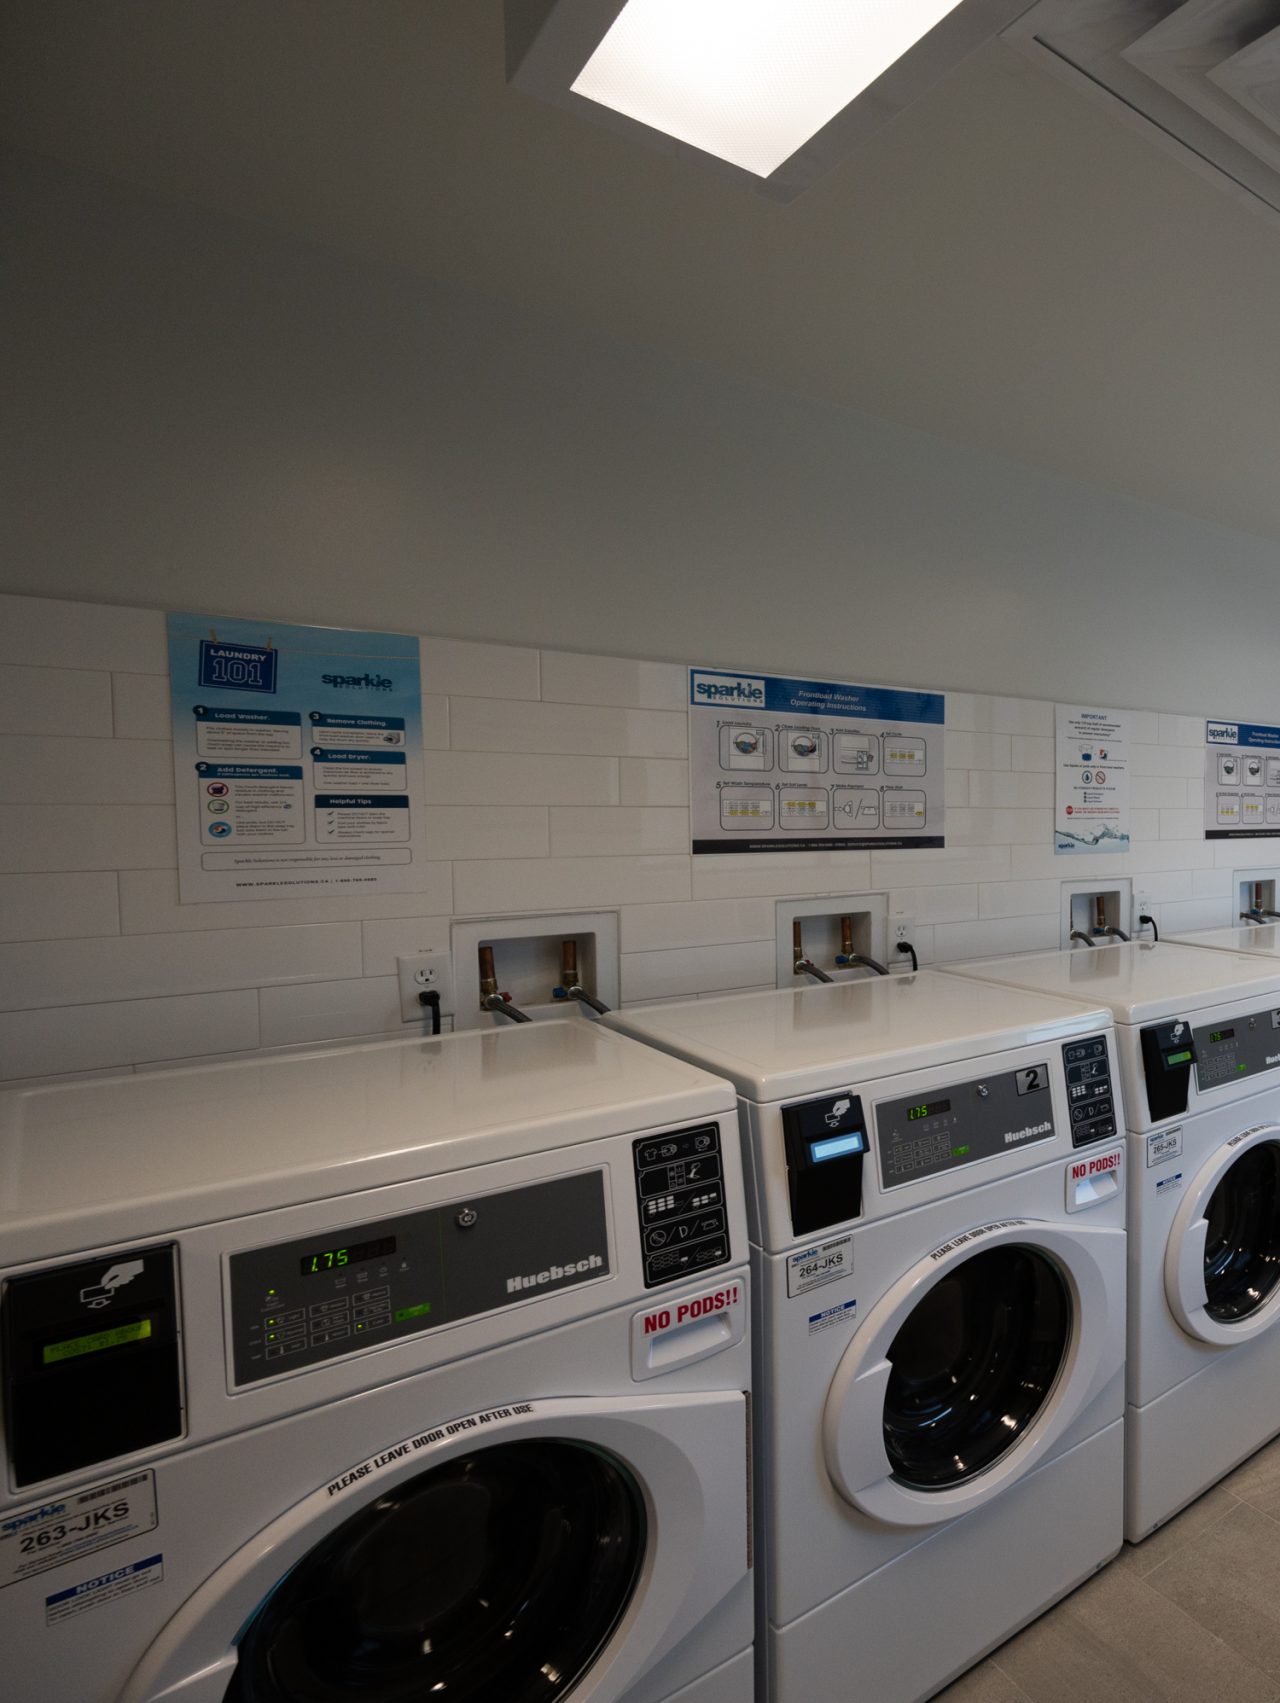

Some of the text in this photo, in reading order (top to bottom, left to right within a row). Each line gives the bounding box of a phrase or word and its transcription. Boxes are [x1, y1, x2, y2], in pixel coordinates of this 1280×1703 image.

[210, 648, 267, 661] LAUNDRY
[212, 658, 263, 686] 101
[321, 673, 392, 688] sparkle
[696, 681, 763, 700] sparkle
[798, 690, 860, 702] Frontload Washer
[712, 695, 763, 704] SOLUTIONS
[790, 699, 867, 712] Operating Instructions
[238, 713, 270, 721] Washer.
[716, 720, 720, 728] 1
[776, 724, 781, 732] 2
[1208, 727, 1237, 740] sparkle
[716, 781, 721, 789] 5
[775, 782, 781, 790] 6
[830, 783, 835, 791] 7
[1025, 1069, 1040, 1091] 2
[910, 1105, 928, 1120] 1.75
[1004, 1121, 1052, 1143] Huebsch
[1153, 1138, 1177, 1154] 265-JKS
[1072, 1153, 1120, 1179] NO PODS!!
[930, 1243, 954, 1260] PLEASE
[952, 1235, 972, 1247] LEAVE
[969, 1228, 987, 1238] DOOR
[984, 1223, 1001, 1232] OPEN
[310, 1249, 349, 1273] 1.75
[792, 1249, 818, 1263] sparkle
[799, 1253, 843, 1278] 264-JKS
[506, 1254, 603, 1293] Huebsch
[644, 1287, 738, 1333] NO PODS!!
[820, 1304, 845, 1318] NOTICE
[327, 1404, 533, 1496] PLEASE LEAVE DOOR OPEN AFTER USE
[20, 1502, 129, 1553] 263-JKS
[75, 1564, 135, 1594] NOTICE
